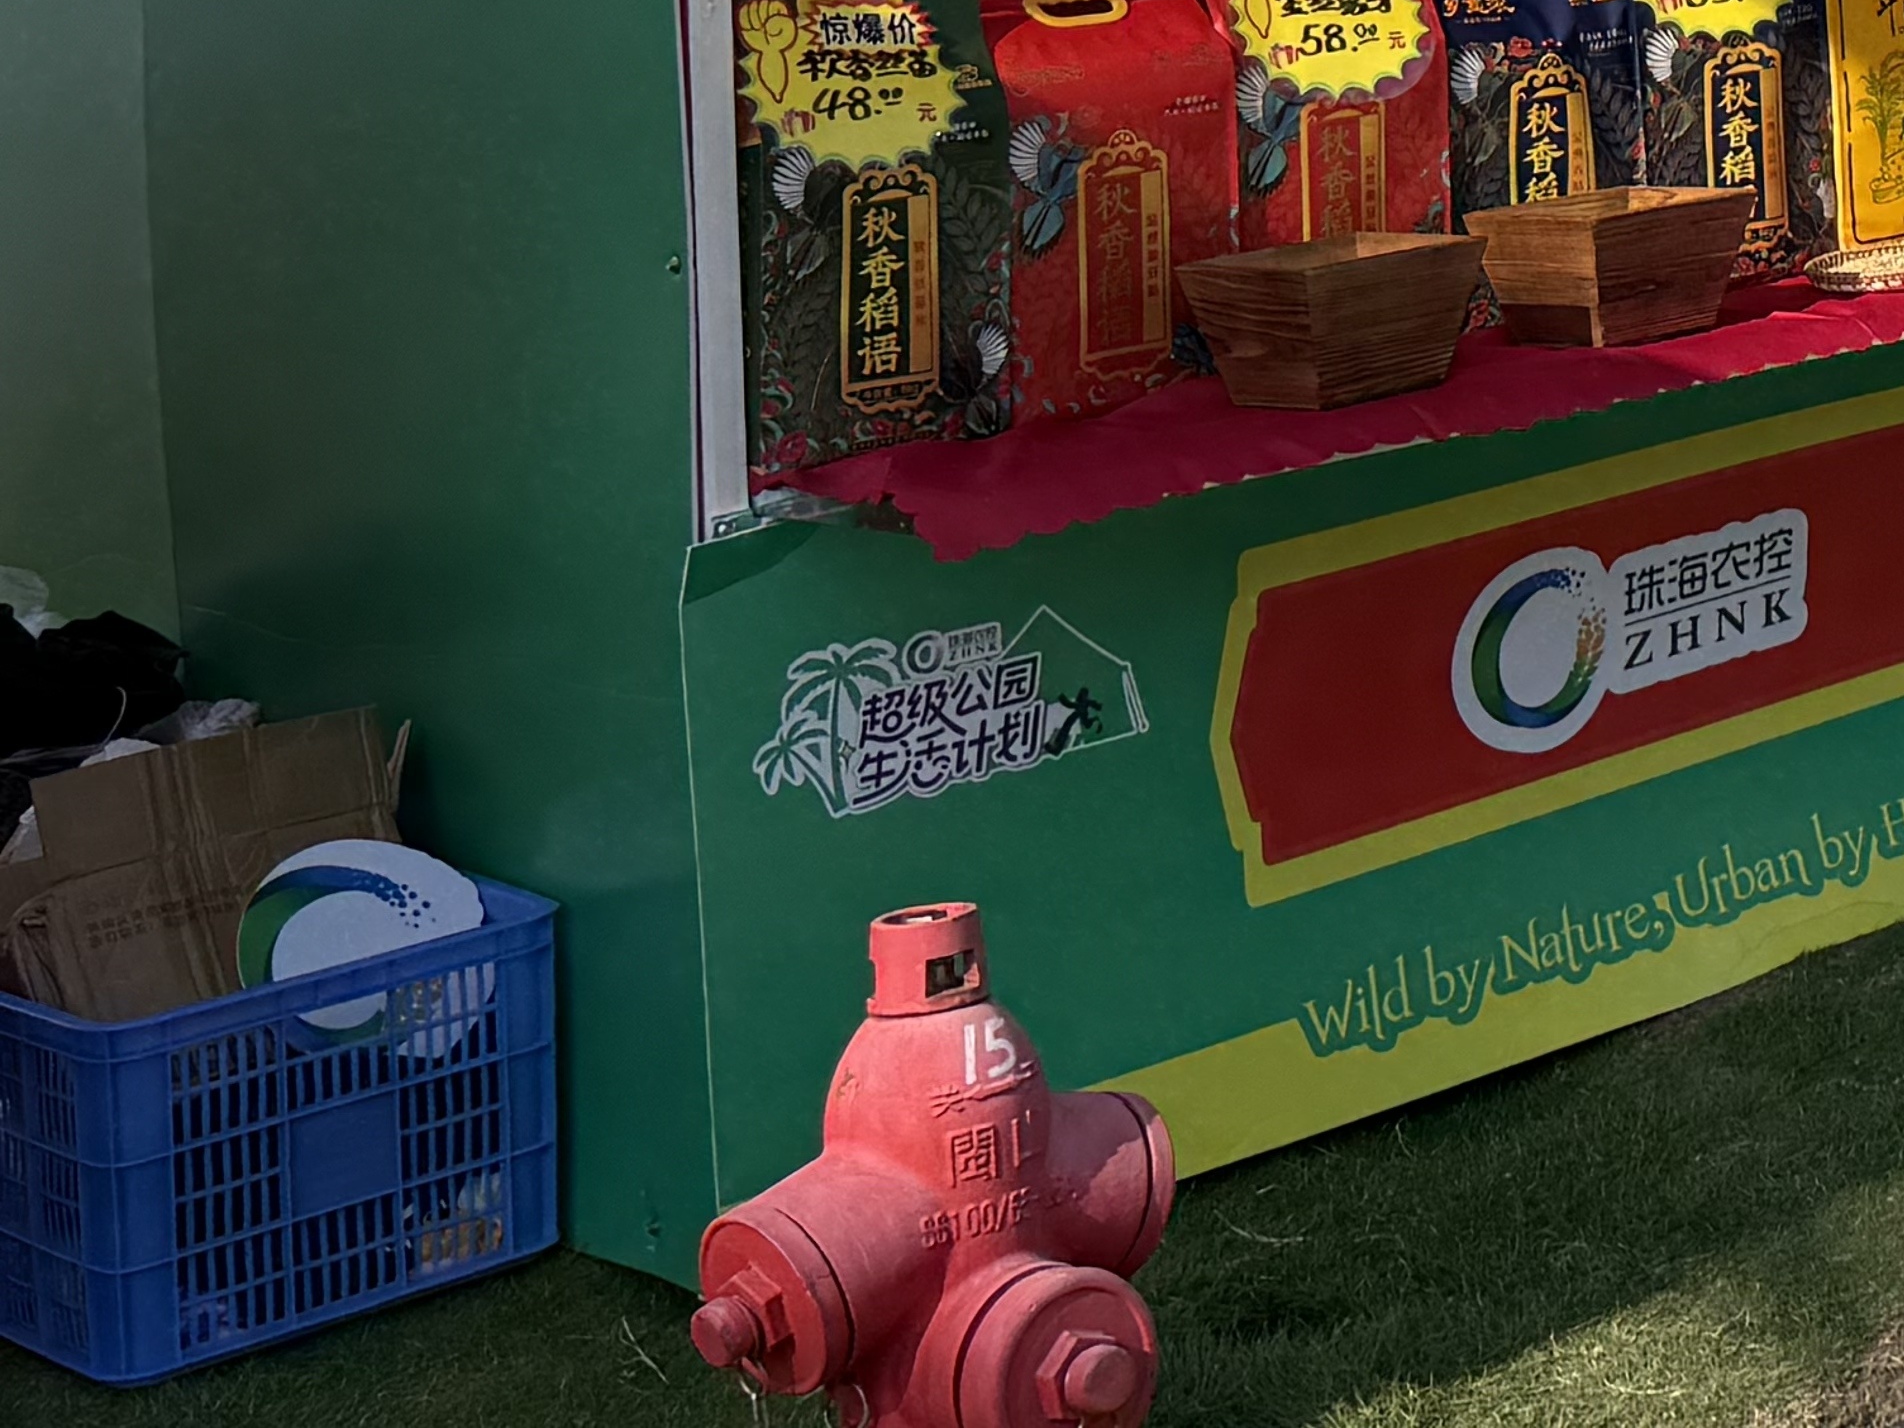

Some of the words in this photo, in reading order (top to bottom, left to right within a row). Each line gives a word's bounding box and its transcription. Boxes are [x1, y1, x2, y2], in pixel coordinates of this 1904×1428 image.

[820, 13, 916, 45] 惊爆价
[855, 207, 905, 375] 秋香稻语
[1624, 528, 1793, 617] 珠海农控
[1624, 588, 1796, 671] ZHNK
[859, 654, 1040, 749] 超级公园
[853, 704, 1040, 805] 生活计划
[1302, 956, 1413, 1045] Wild
[1426, 945, 1481, 1014] by
[1675, 855, 1811, 918] Urban
[1812, 814, 1866, 876] by
[963, 1017, 1016, 1085] 15
